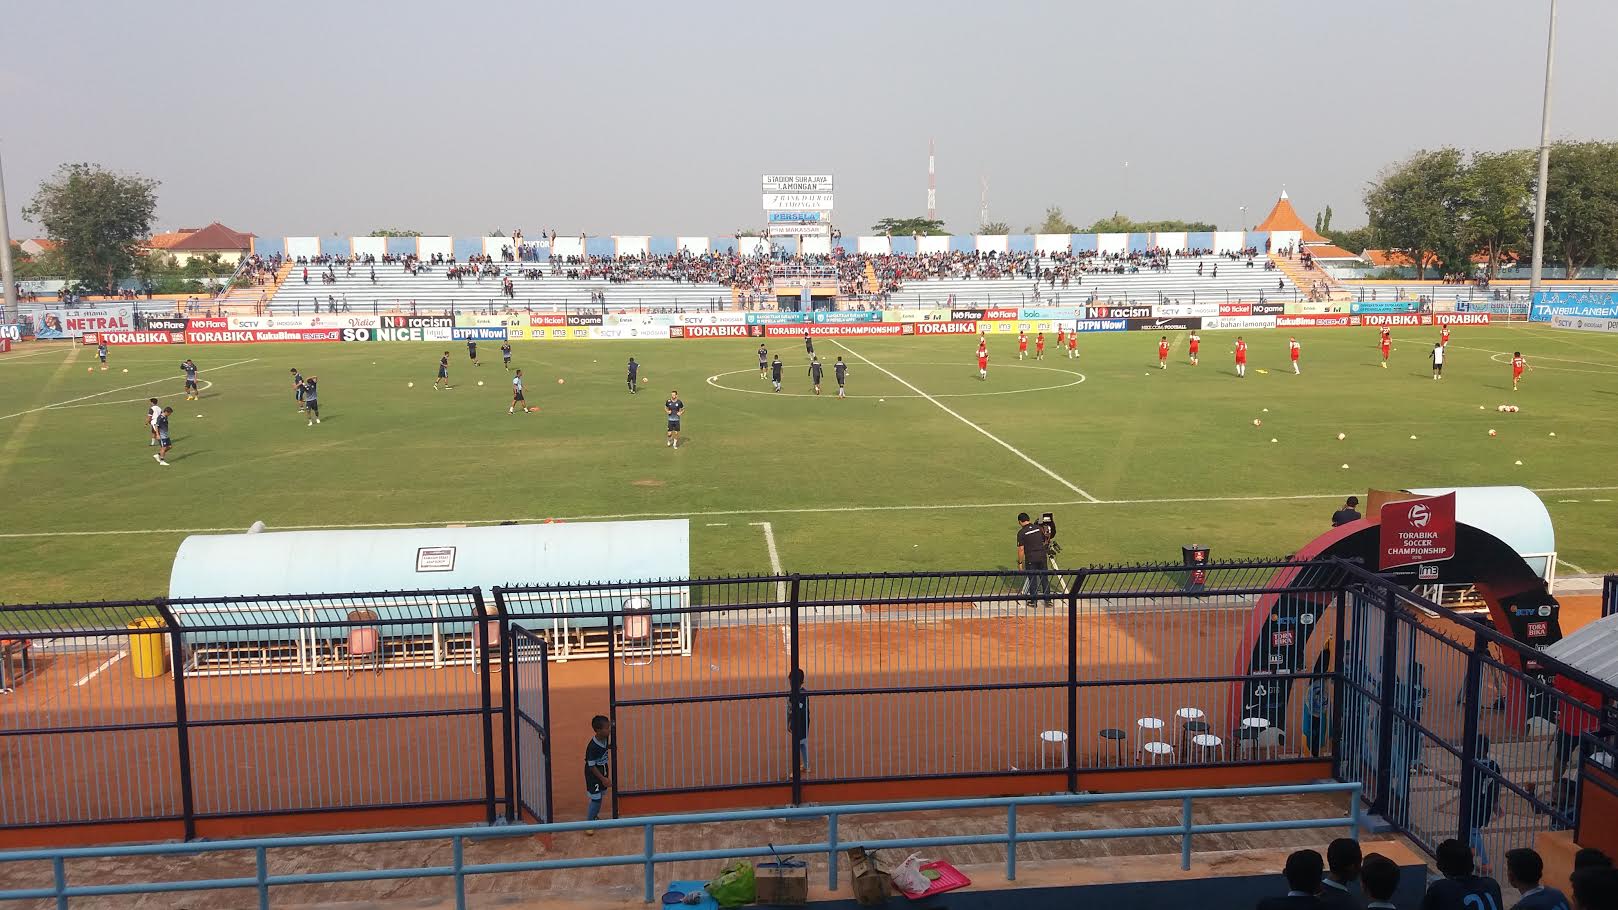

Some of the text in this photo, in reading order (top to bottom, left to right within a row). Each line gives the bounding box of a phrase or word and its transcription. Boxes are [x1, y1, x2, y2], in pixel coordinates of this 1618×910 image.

[1110, 307, 1149, 317] racism
[67, 316, 128, 330] NETRAL
[192, 320, 227, 328] NO Flare
[408, 316, 452, 328] racism
[580, 317, 602, 325] game
[1242, 320, 1275, 328] lamongan
[1364, 315, 1419, 325] TORABIKA
[1436, 314, 1489, 324] TORABIKA
[917, 323, 975, 333] TORABIKA
[1077, 321, 1101, 330] BTPN
[1102, 320, 1126, 330] Wow!
[343, 329, 370, 341] SO
[376, 329, 422, 341] NICE
[453, 329, 479, 338] BTPN
[480, 329, 507, 338] Wow!
[687, 327, 747, 336] TORABIKA
[768, 326, 900, 335] TORABIKA SOCCER CHAMPIONSHIP
[102, 333, 168, 343] TORABIKA
[188, 332, 254, 342] TORABIKA
[256, 331, 301, 340] KukuBima
[1387, 547, 1447, 555] CHAMPIONSHIP
[1516, 608, 1536, 616] SCTV
